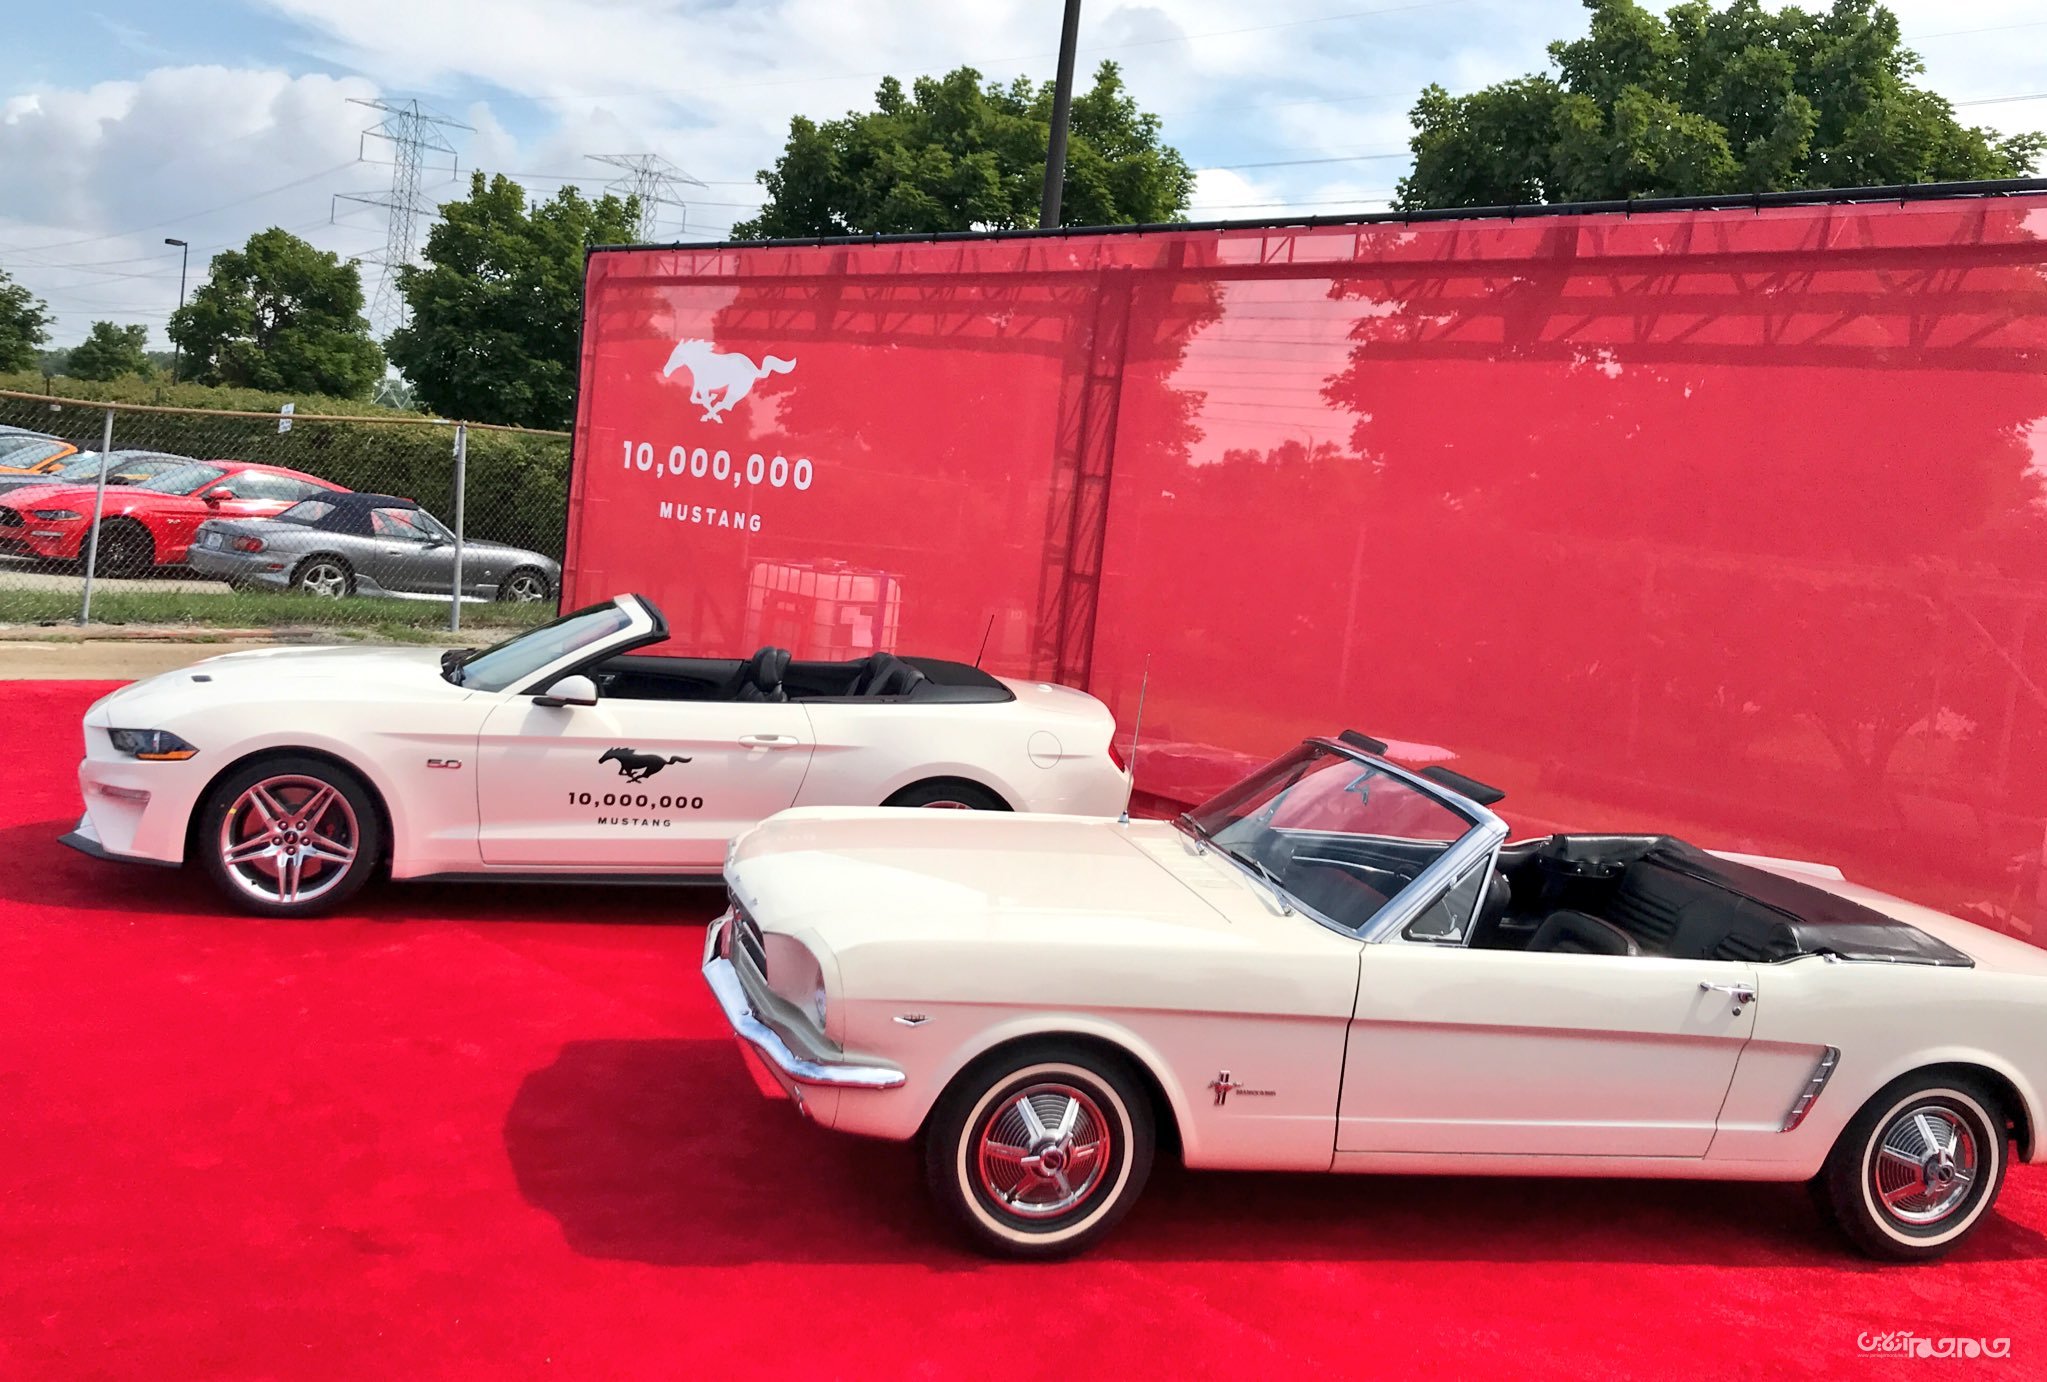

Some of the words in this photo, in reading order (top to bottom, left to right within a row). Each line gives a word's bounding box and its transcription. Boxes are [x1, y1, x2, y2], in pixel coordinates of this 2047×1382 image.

[622, 440, 813, 491] 10,000,000
[659, 501, 762, 532] MUSTANG
[568, 791, 704, 810] 10,000,000
[597, 816, 672, 828] MUSTANG
